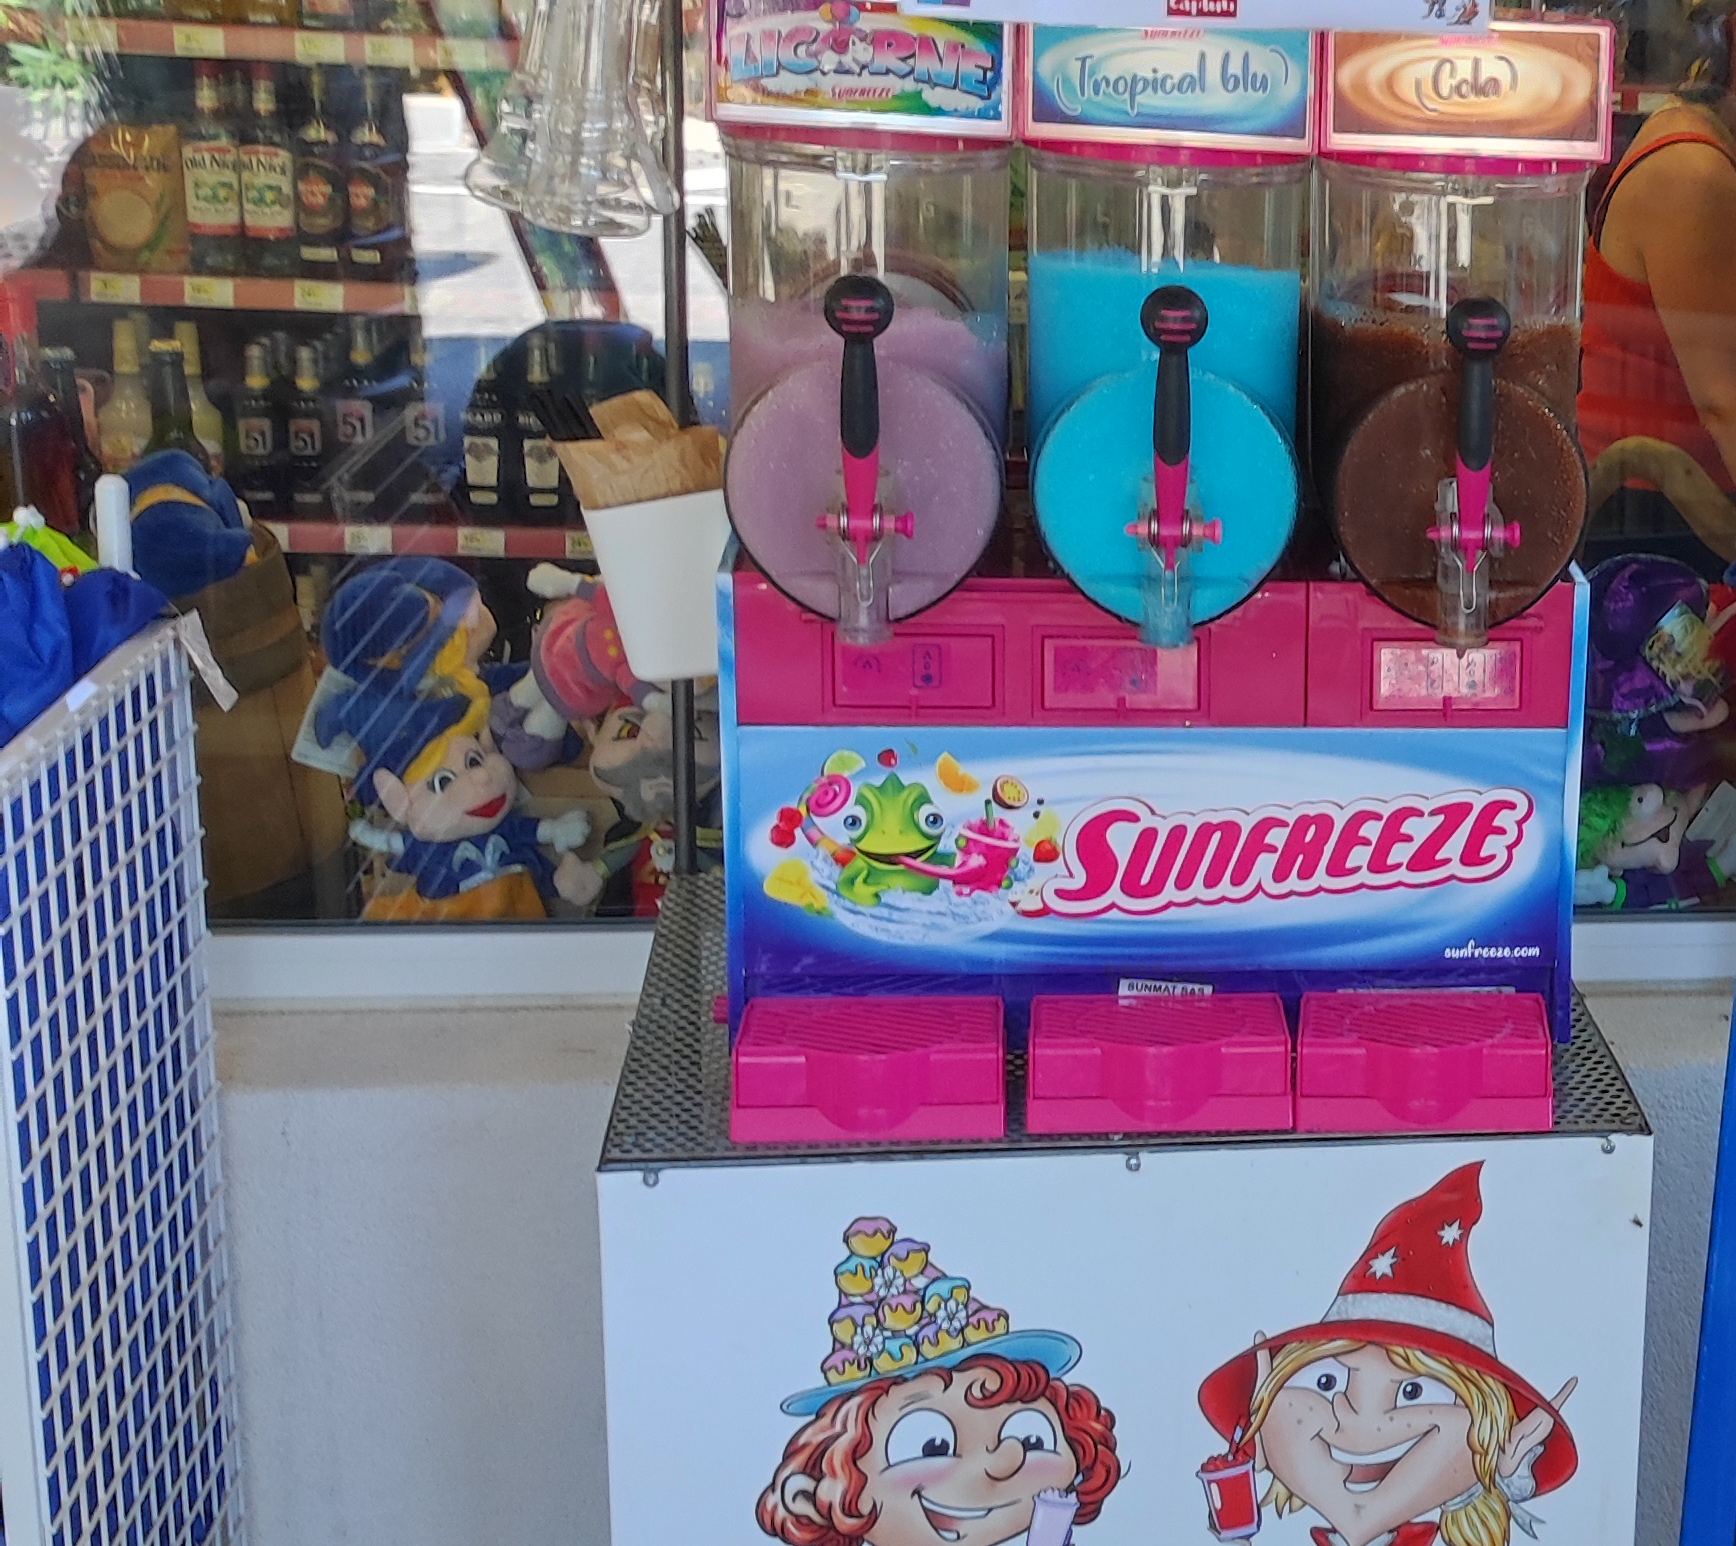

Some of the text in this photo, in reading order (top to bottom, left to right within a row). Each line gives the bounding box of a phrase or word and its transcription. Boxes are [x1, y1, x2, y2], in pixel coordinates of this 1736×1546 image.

[1074, 49, 1271, 117] Tropical blu
[1433, 57, 1501, 100] Cola
[1050, 793, 1529, 907] SUNFREEZE
[1443, 940, 1541, 959] sunfreeze.com
